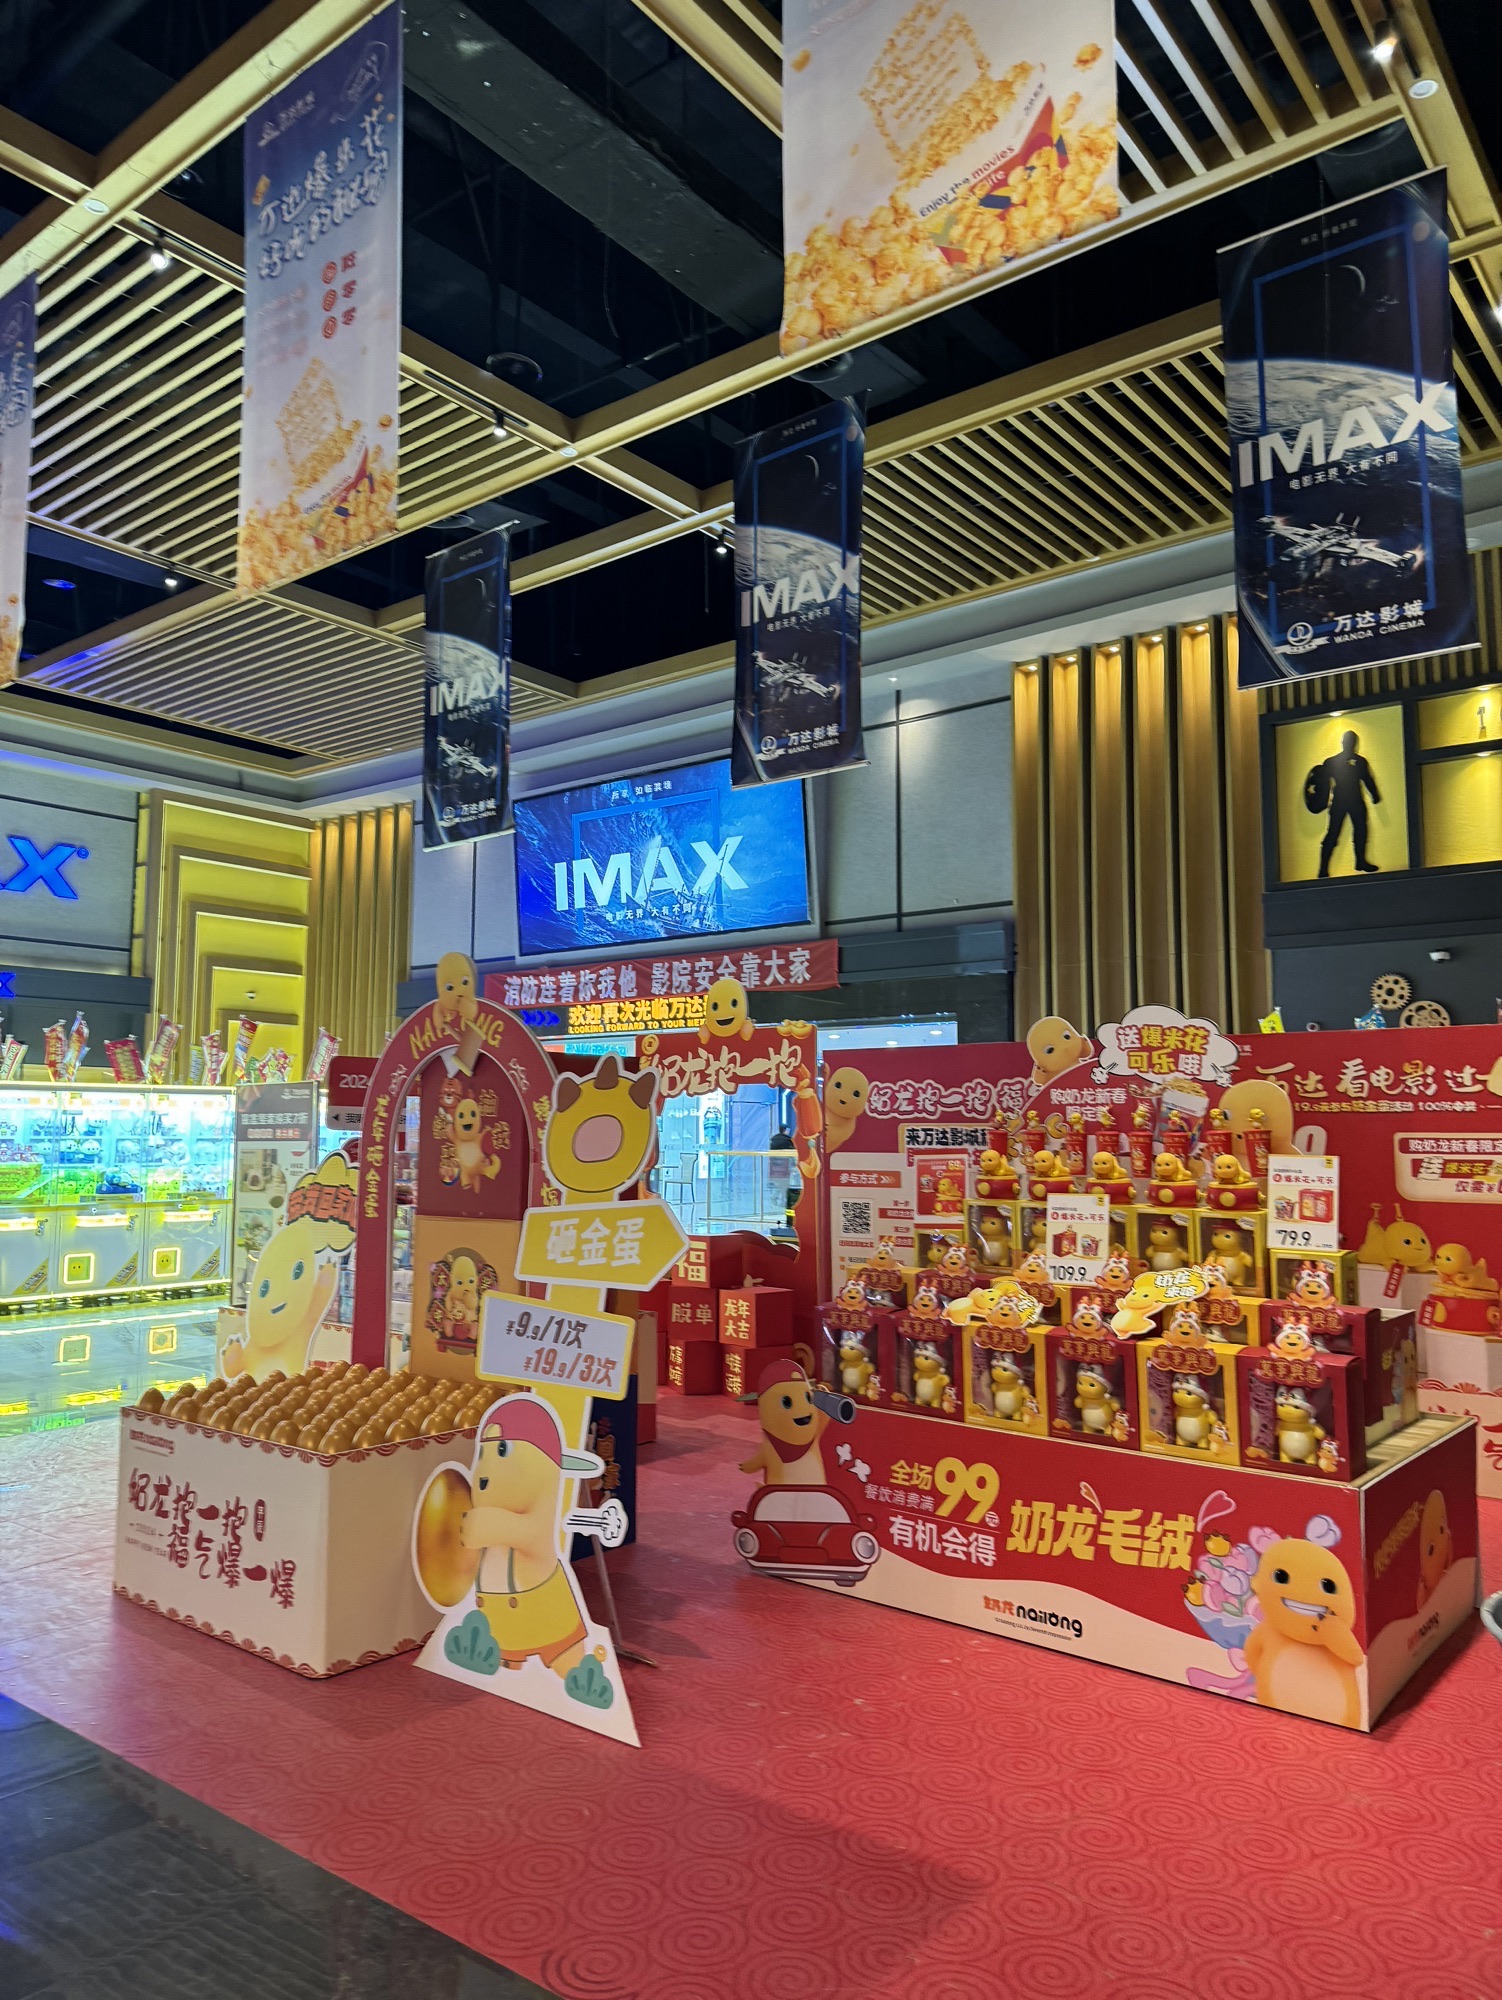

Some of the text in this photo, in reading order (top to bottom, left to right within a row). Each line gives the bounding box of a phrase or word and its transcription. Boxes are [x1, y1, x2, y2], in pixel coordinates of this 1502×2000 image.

[919, 193, 952, 217] Enjoy
[972, 145, 1015, 180] movies
[1238, 381, 1454, 488] IMAX
[1289, 451, 1399, 490] 电影无界 大有不同
[741, 556, 861, 627] IMAX
[1333, 599, 1425, 633] 万达影城
[1333, 618, 1426, 644] WANDA CINEMA
[787, 723, 840, 746] 万达影城
[554, 835, 750, 911] IMAX
[503, 947, 811, 1006] 消防连着你我他 影院安全靠大家
[568, 1025, 605, 1034] LOOKING
[606, 1022, 646, 1032] FORWARD
[647, 1020, 659, 1029] TO
[661, 1019, 685, 1029] YOUR
[1117, 1024, 1210, 1055] 送爆米花
[1128, 1050, 1202, 1076] 可乐哦
[1335, 1058, 1438, 1098] 看电影
[1050, 1088, 1128, 1105] 购奶龙新春
[546, 1217, 645, 1267] 砸金蛋
[675, 1241, 708, 1283] 福
[724, 1298, 751, 1319] 龙年
[506, 1310, 589, 1349] ¥9.9/1次
[724, 1320, 750, 1340] 大吉
[523, 1347, 617, 1387] ¥19.9/3次
[889, 1460, 933, 1491] 全场
[934, 1457, 1000, 1524] 99
[864, 1483, 935, 1514] 餐饮消费满
[889, 1515, 997, 1567] 有机会得
[1006, 1499, 1197, 1572] 奶龙毛绒
[1016, 1605, 1083, 1639] nailong
